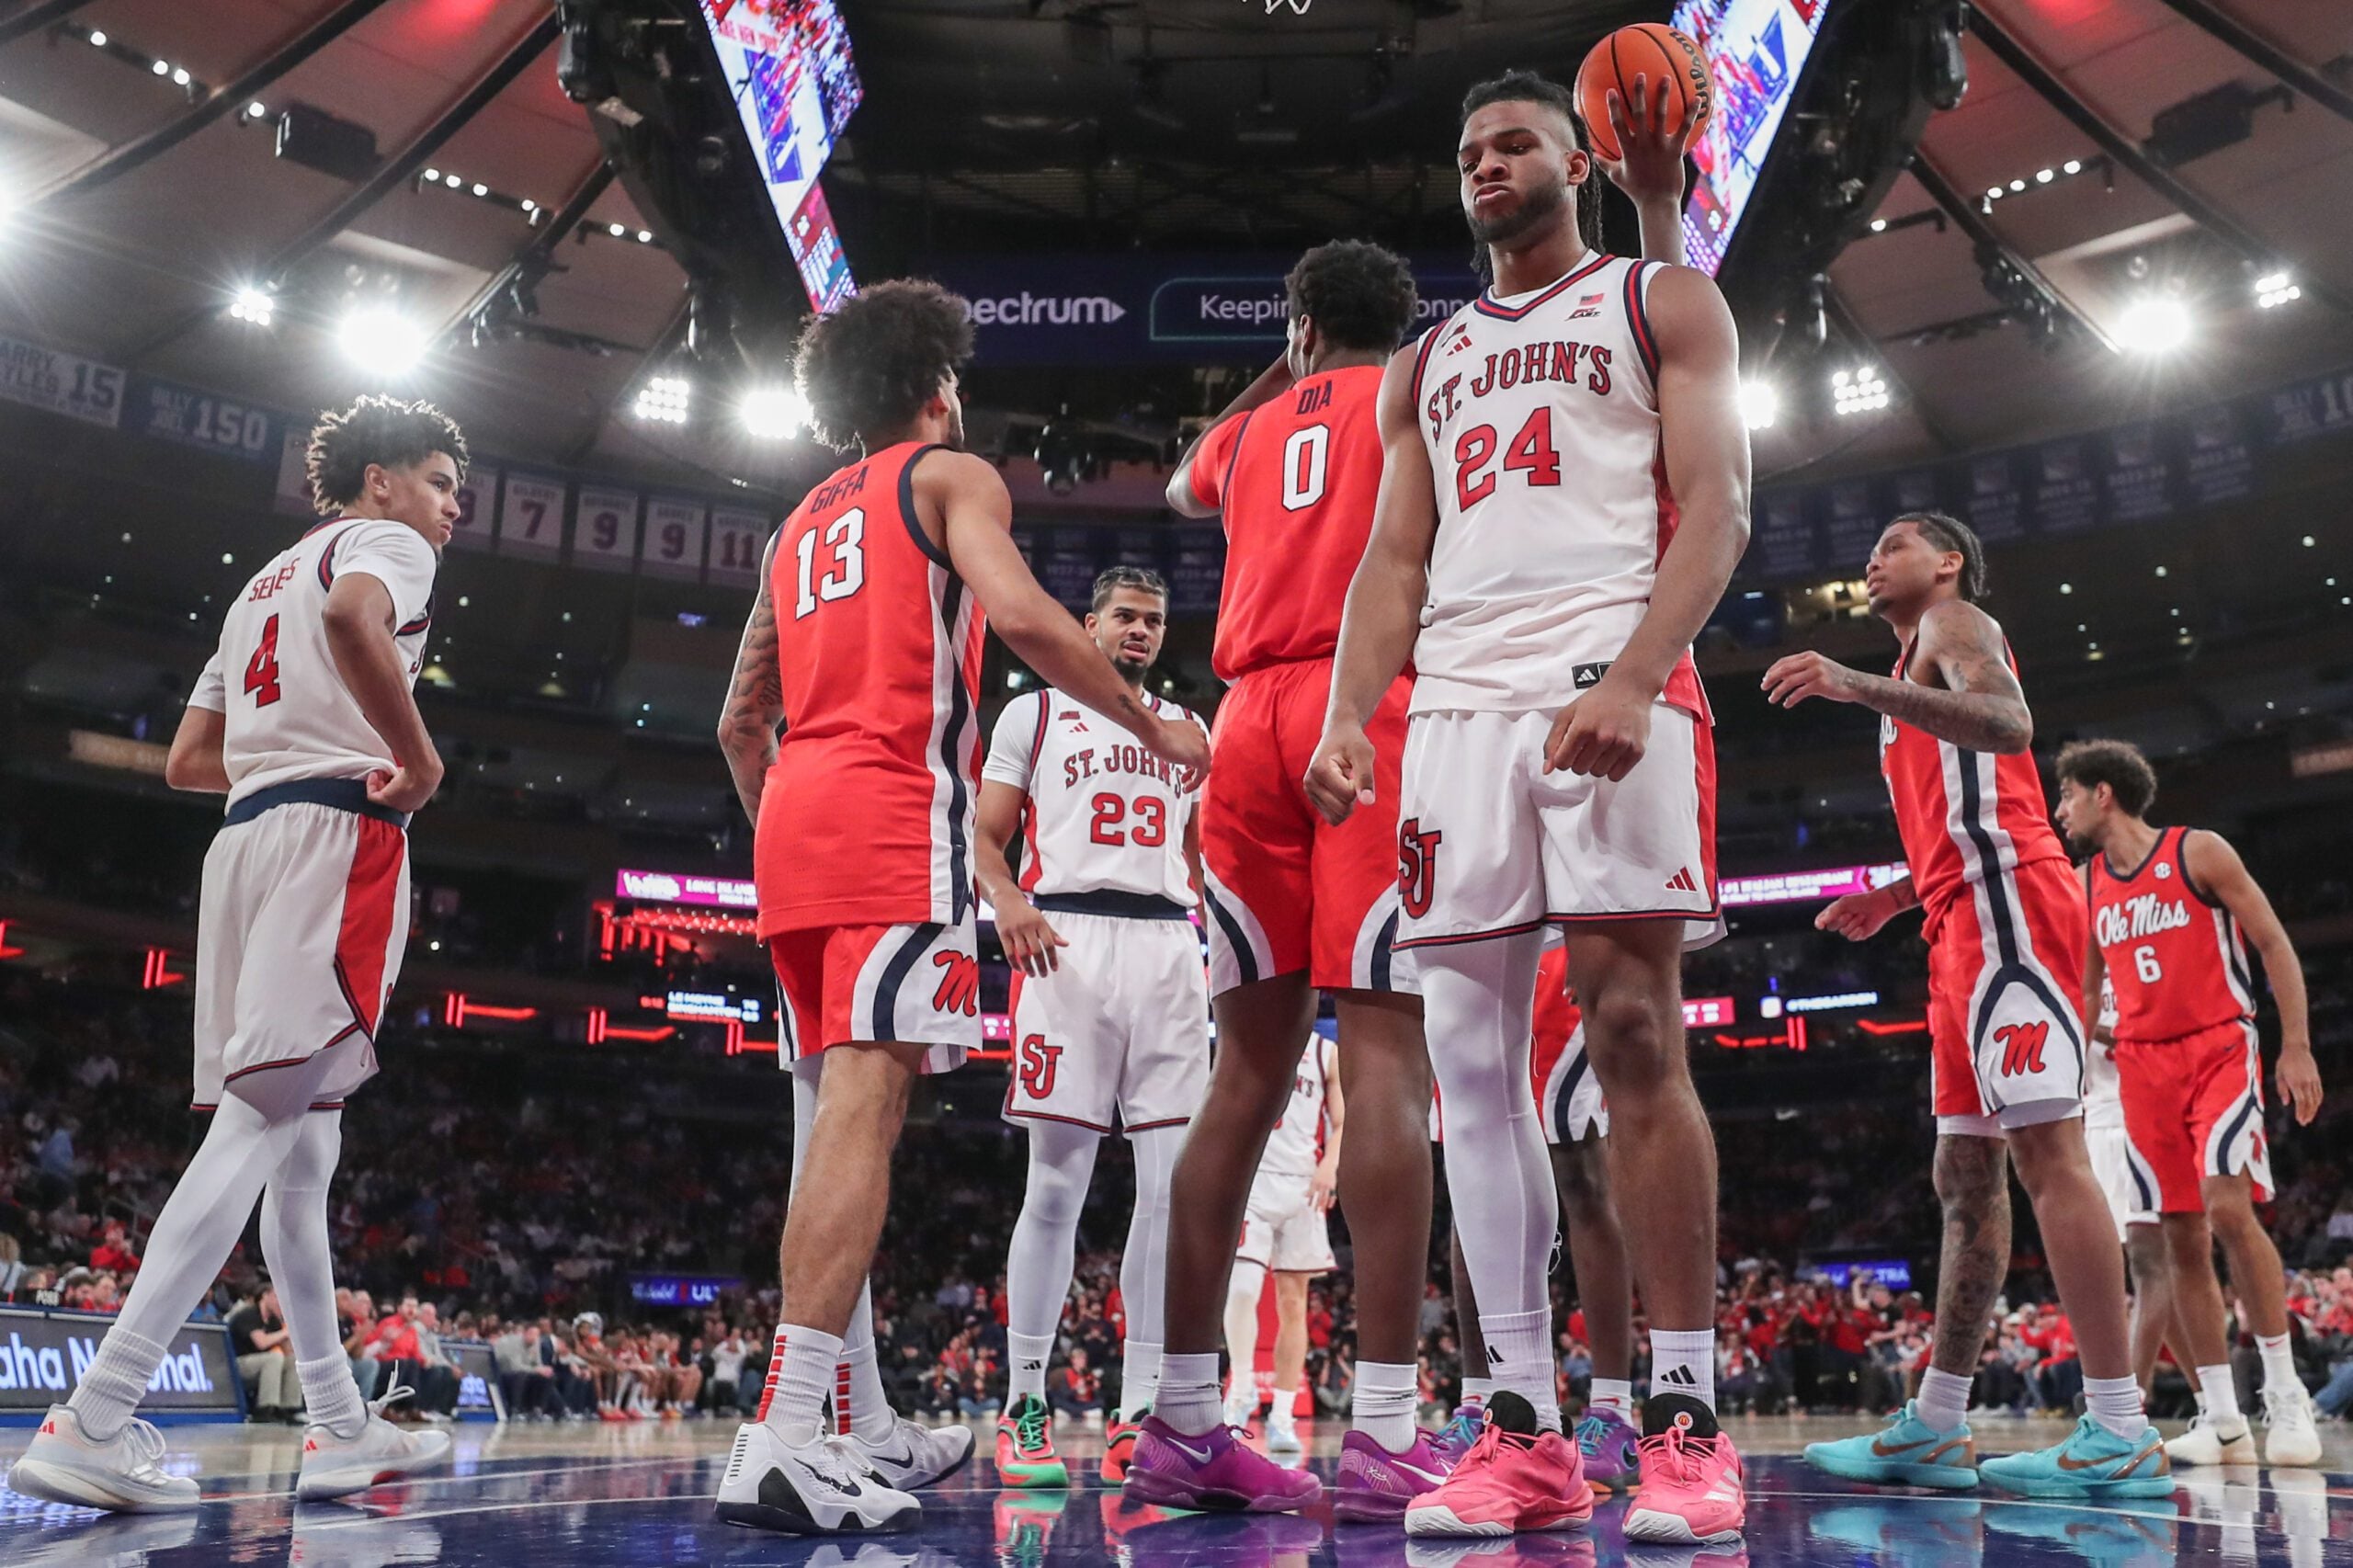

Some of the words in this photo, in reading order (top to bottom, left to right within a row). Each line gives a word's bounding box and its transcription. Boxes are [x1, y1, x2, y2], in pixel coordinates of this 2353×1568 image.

[69, 363, 117, 410] 15
[1296, 380, 1333, 415] DIA
[1427, 370, 1462, 449] ST.
[1471, 341, 1612, 399] JOHN'S
[193, 399, 268, 451] 150
[1282, 424, 1331, 512] 0
[1455, 405, 1562, 513] 24
[811, 464, 869, 515] GIFFA
[520, 498, 548, 539] 7
[593, 511, 619, 551] 9
[661, 523, 686, 560] 9
[721, 530, 756, 569] 11
[795, 506, 866, 621] 13
[244, 612, 280, 709] 4
[1063, 748, 1099, 790] ST.
[1090, 791, 1166, 847] 23
[2096, 903, 2131, 949] Ole
[2124, 892, 2190, 938] Miss
[2133, 944, 2162, 983] 6
